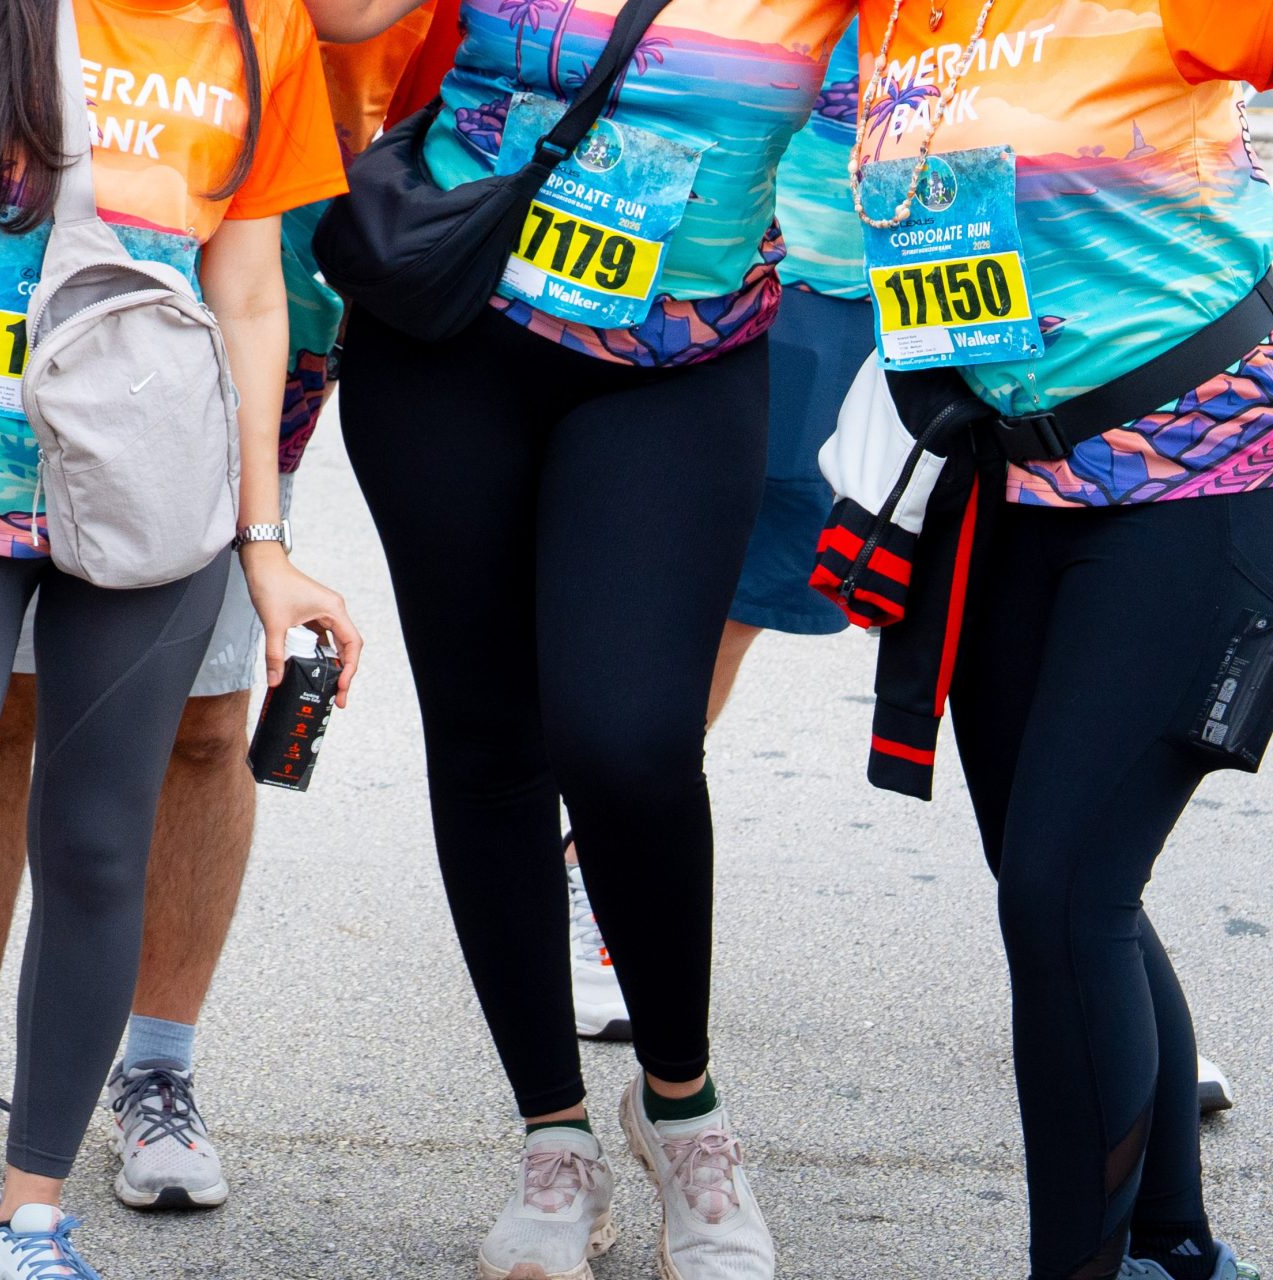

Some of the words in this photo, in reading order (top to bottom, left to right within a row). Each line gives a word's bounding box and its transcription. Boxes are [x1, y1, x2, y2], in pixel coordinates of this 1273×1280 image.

[889, 86, 982, 138] BANK
[576, 200, 593, 212] BANK
[615, 197, 647, 220] RUN
[617, 218, 641, 232] 2026
[890, 225, 963, 248] CORPORATE
[967, 221, 991, 238] RUN
[899, 217, 935, 229] LEXUS
[548, 281, 602, 311] Walker
[885, 258, 1012, 326] 17150
[953, 330, 1001, 348] Walker
